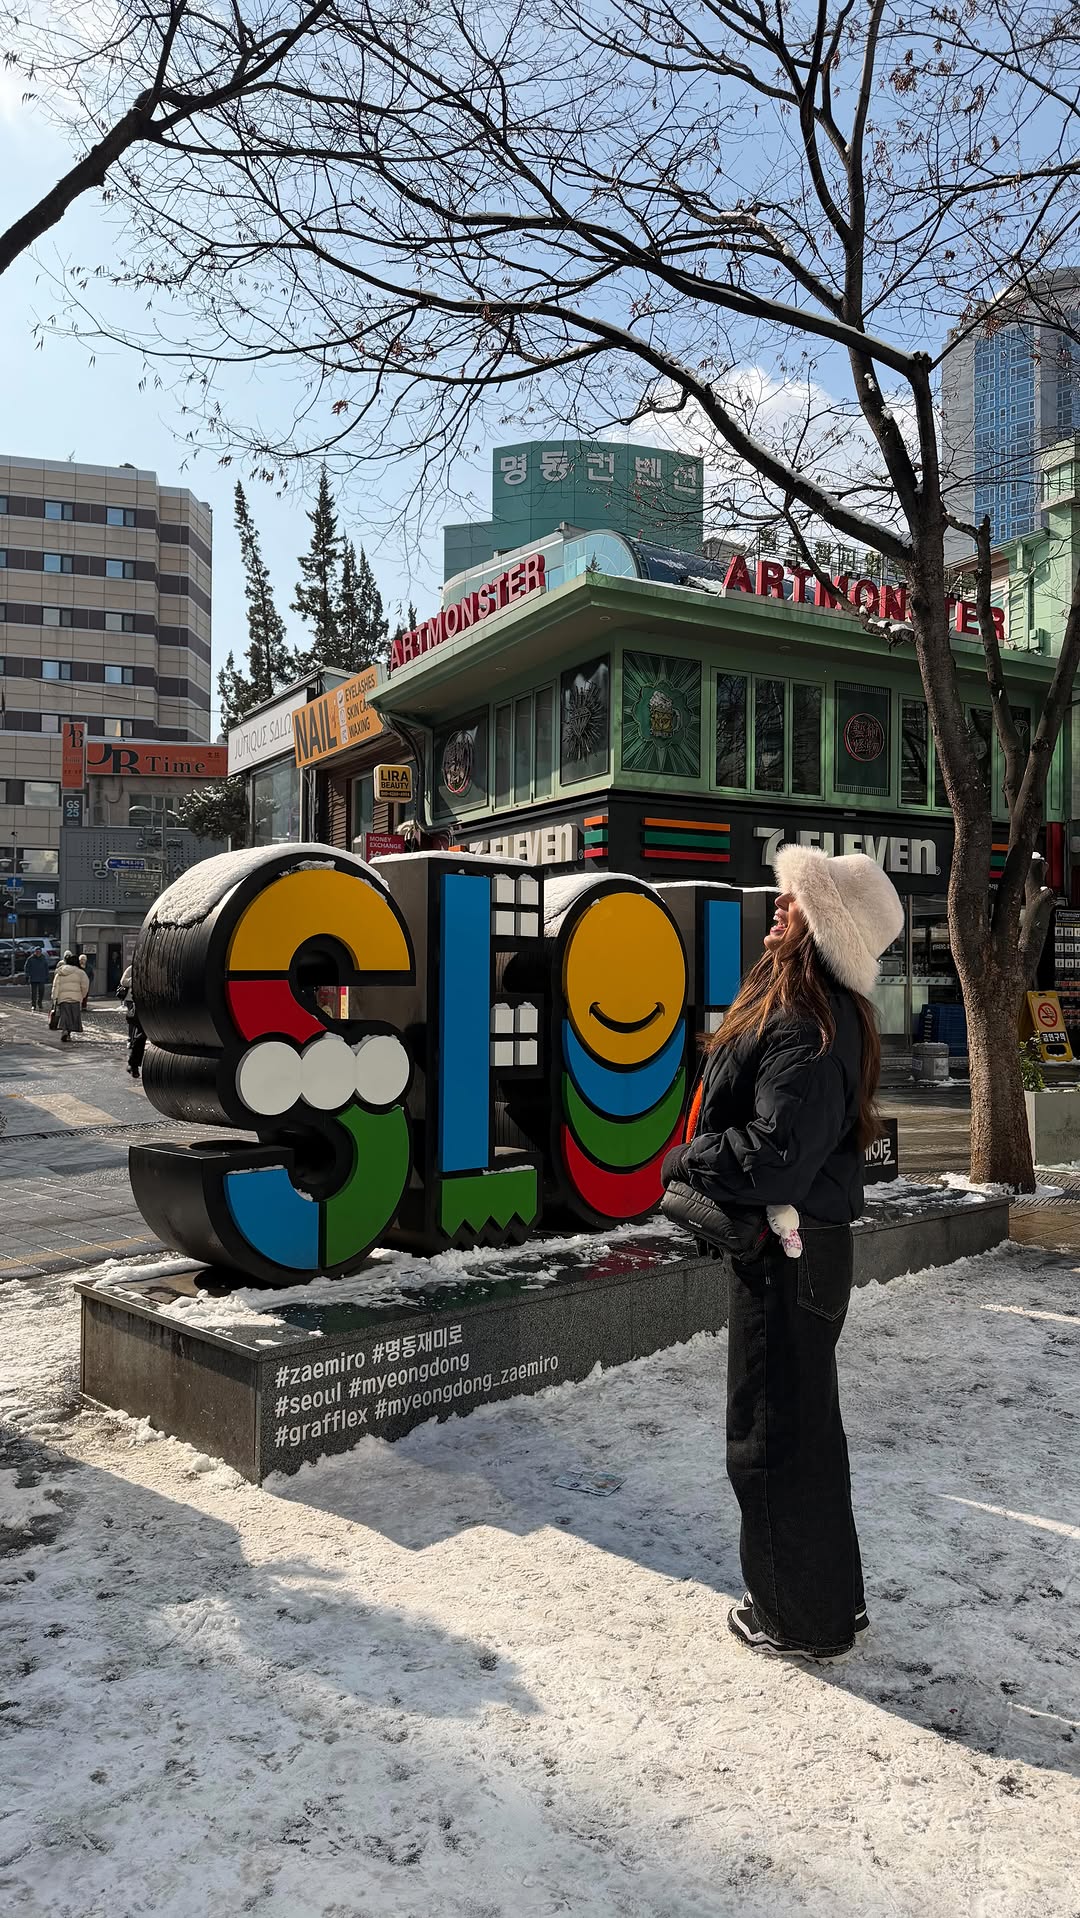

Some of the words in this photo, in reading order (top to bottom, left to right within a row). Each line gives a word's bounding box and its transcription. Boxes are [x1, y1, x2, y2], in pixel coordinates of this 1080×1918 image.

[722, 555, 1006, 640] ARTMONER
[390, 553, 546, 672] ARTMONSTER
[345, 673, 376, 702] EYELASHES
[347, 702, 360, 720] SKIN
[294, 699, 338, 763] NAIL
[348, 716, 371, 739] WAXING
[145, 755, 206, 774] Time
[380, 770, 409, 782] LIRA
[381, 781, 409, 790] BEAUTY
[66, 800, 80, 809] GS
[66, 808, 80, 818] 25
[1042, 1032, 1066, 1043] 금연구역
[274, 1351, 365, 1389] #zaemiro
[371, 1324, 463, 1364] #명동재미로
[274, 1381, 341, 1418] #seoul
[348, 1352, 470, 1399] #myeongdong
[273, 1406, 368, 1448] #grafflex
[374, 1353, 559, 1420] #myeongdong_zaemiro
